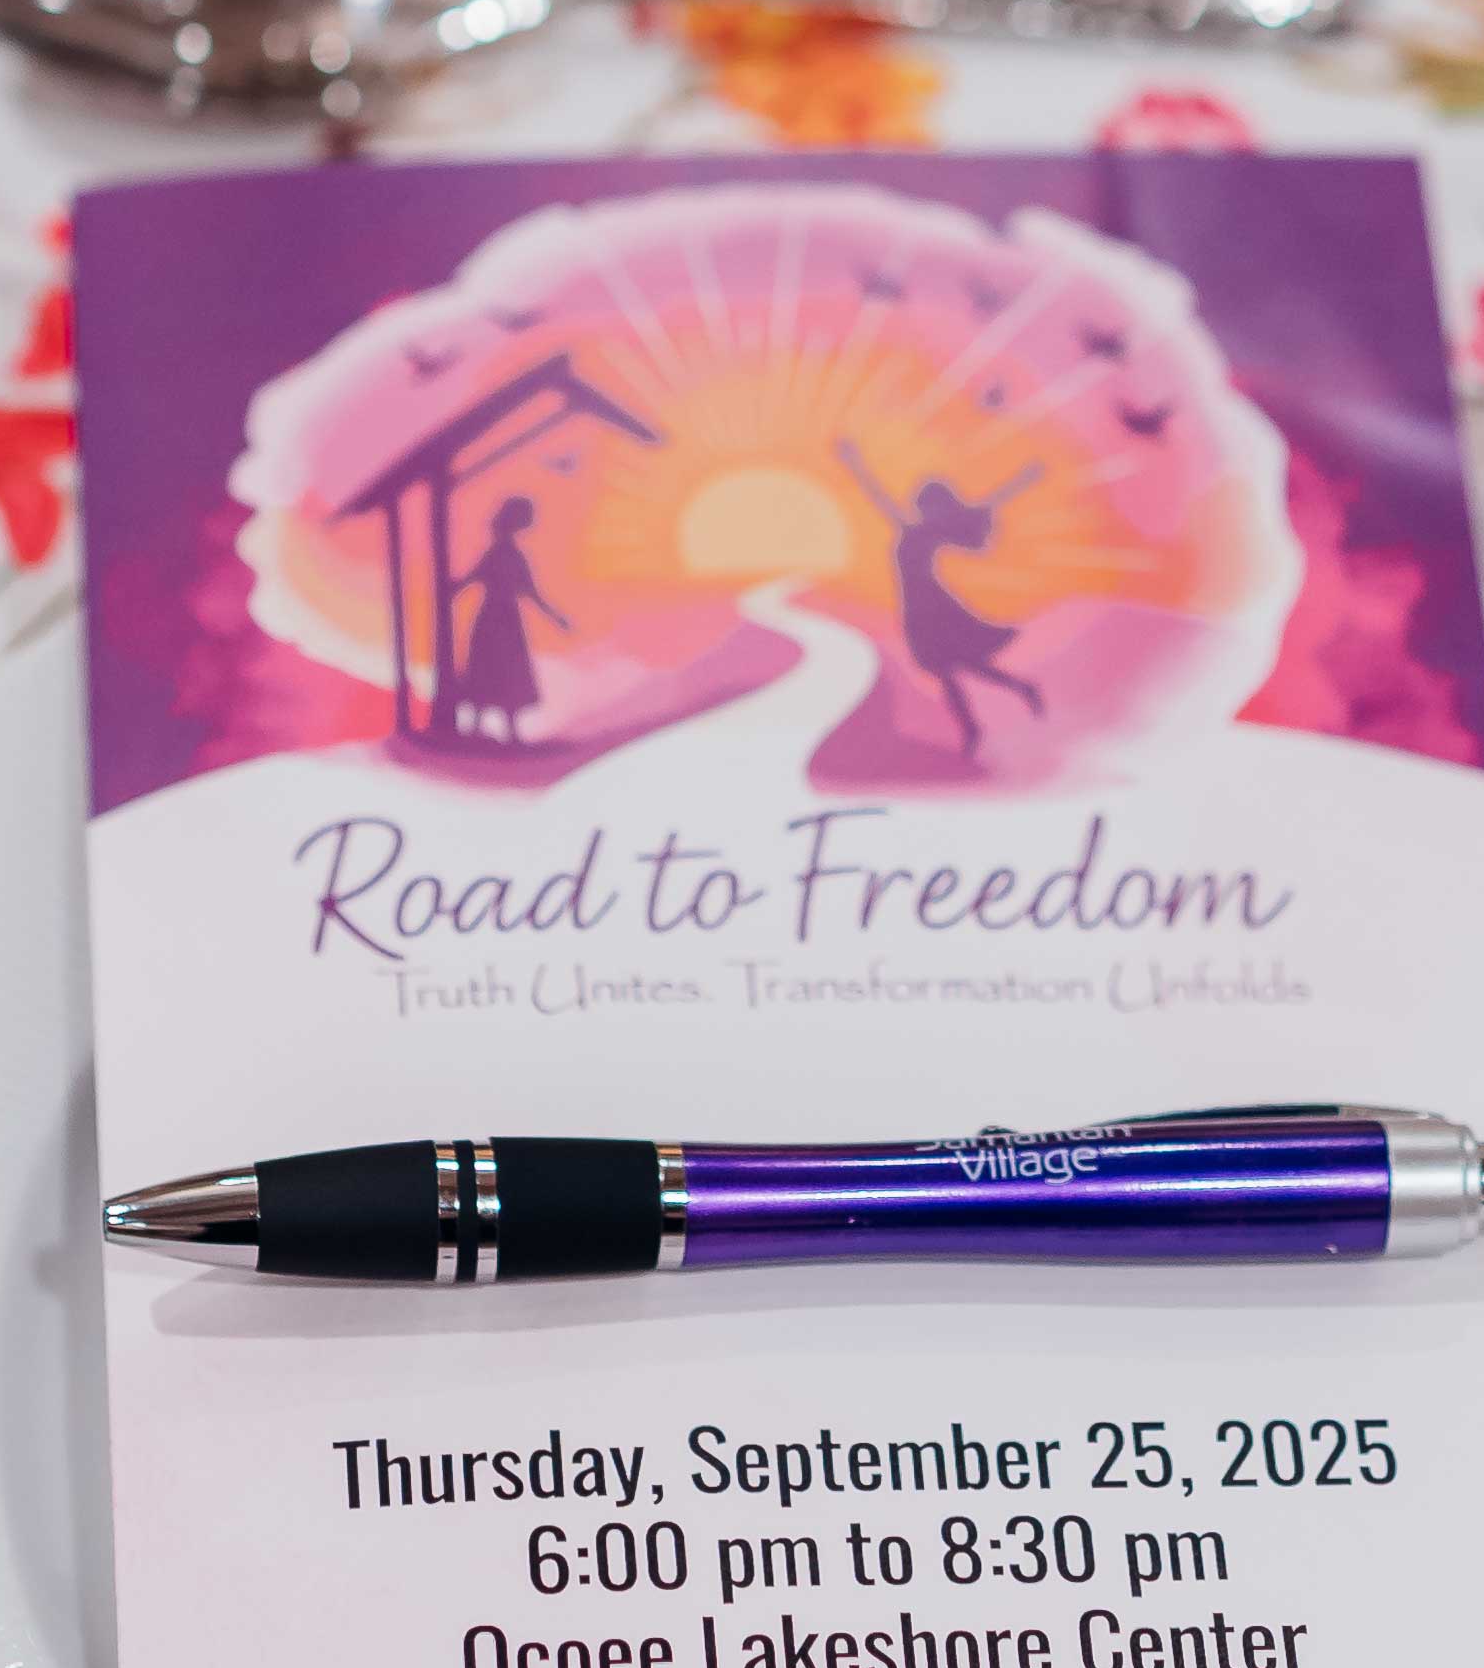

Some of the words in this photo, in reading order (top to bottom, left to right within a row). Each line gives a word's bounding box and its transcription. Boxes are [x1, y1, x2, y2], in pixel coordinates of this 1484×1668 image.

[293, 816, 617, 961] Road
[636, 830, 765, 935] to
[786, 806, 1293, 944] Freedom
[375, 966, 517, 1016] Truth
[954, 1145, 1099, 1185] Village
[332, 1429, 664, 1510] Thursday,
[687, 1422, 1062, 1509] September
[1086, 1420, 1194, 1498] 25,
[1215, 1418, 1398, 1488] 2025
[527, 1520, 688, 1596] 6:00
[717, 1536, 822, 1605] pm
[845, 1522, 914, 1587] to
[940, 1514, 1096, 1585] 8:30
[1124, 1531, 1229, 1599] pm
